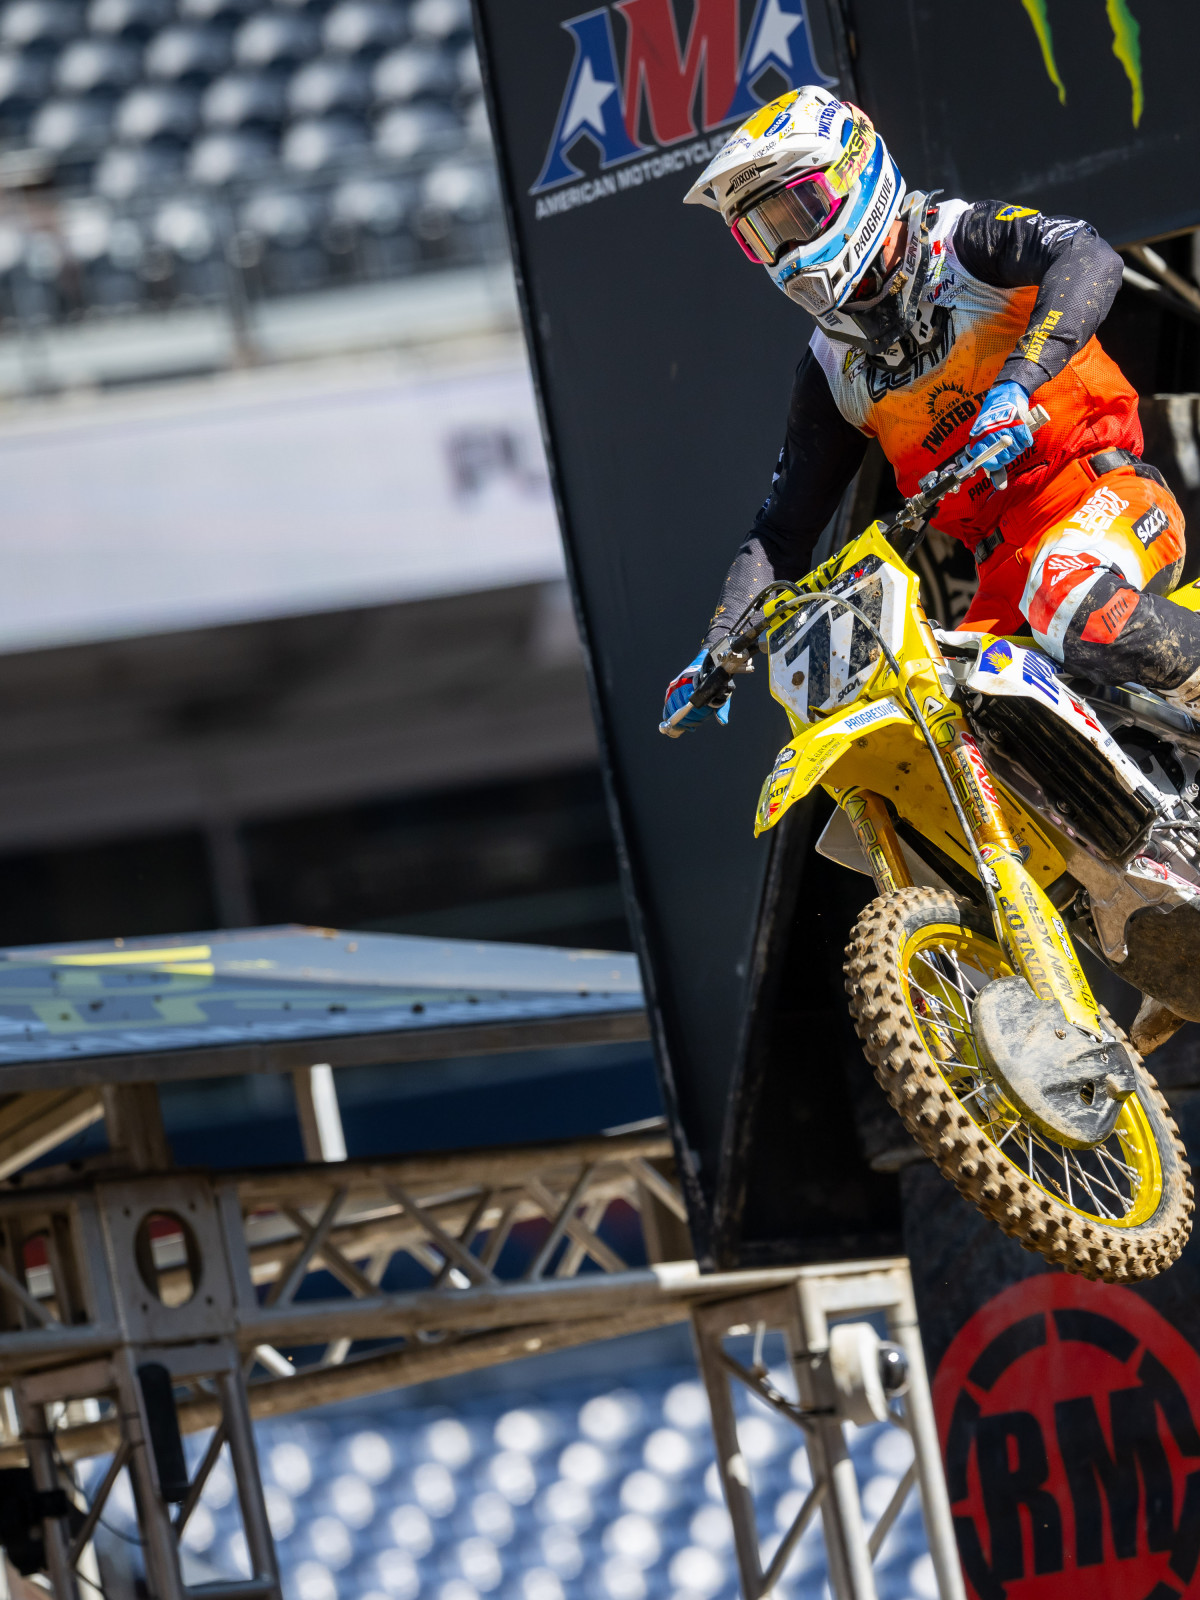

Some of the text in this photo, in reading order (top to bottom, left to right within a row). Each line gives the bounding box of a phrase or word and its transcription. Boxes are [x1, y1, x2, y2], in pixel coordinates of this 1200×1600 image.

[834, 137, 864, 178] EKS
[534, 165, 616, 221] AMERICAN
[854, 175, 894, 260] PROGRESSIVE
[1041, 310, 1063, 337] TEA
[921, 396, 977, 455] TWISTED
[838, 678, 860, 703] SKDA
[844, 702, 897, 730] PROGRESSIVE
[1020, 880, 1054, 952] ACERBIS
[1000, 897, 1053, 1001] DUNLOP
[975, 1385, 1178, 1590] RM
